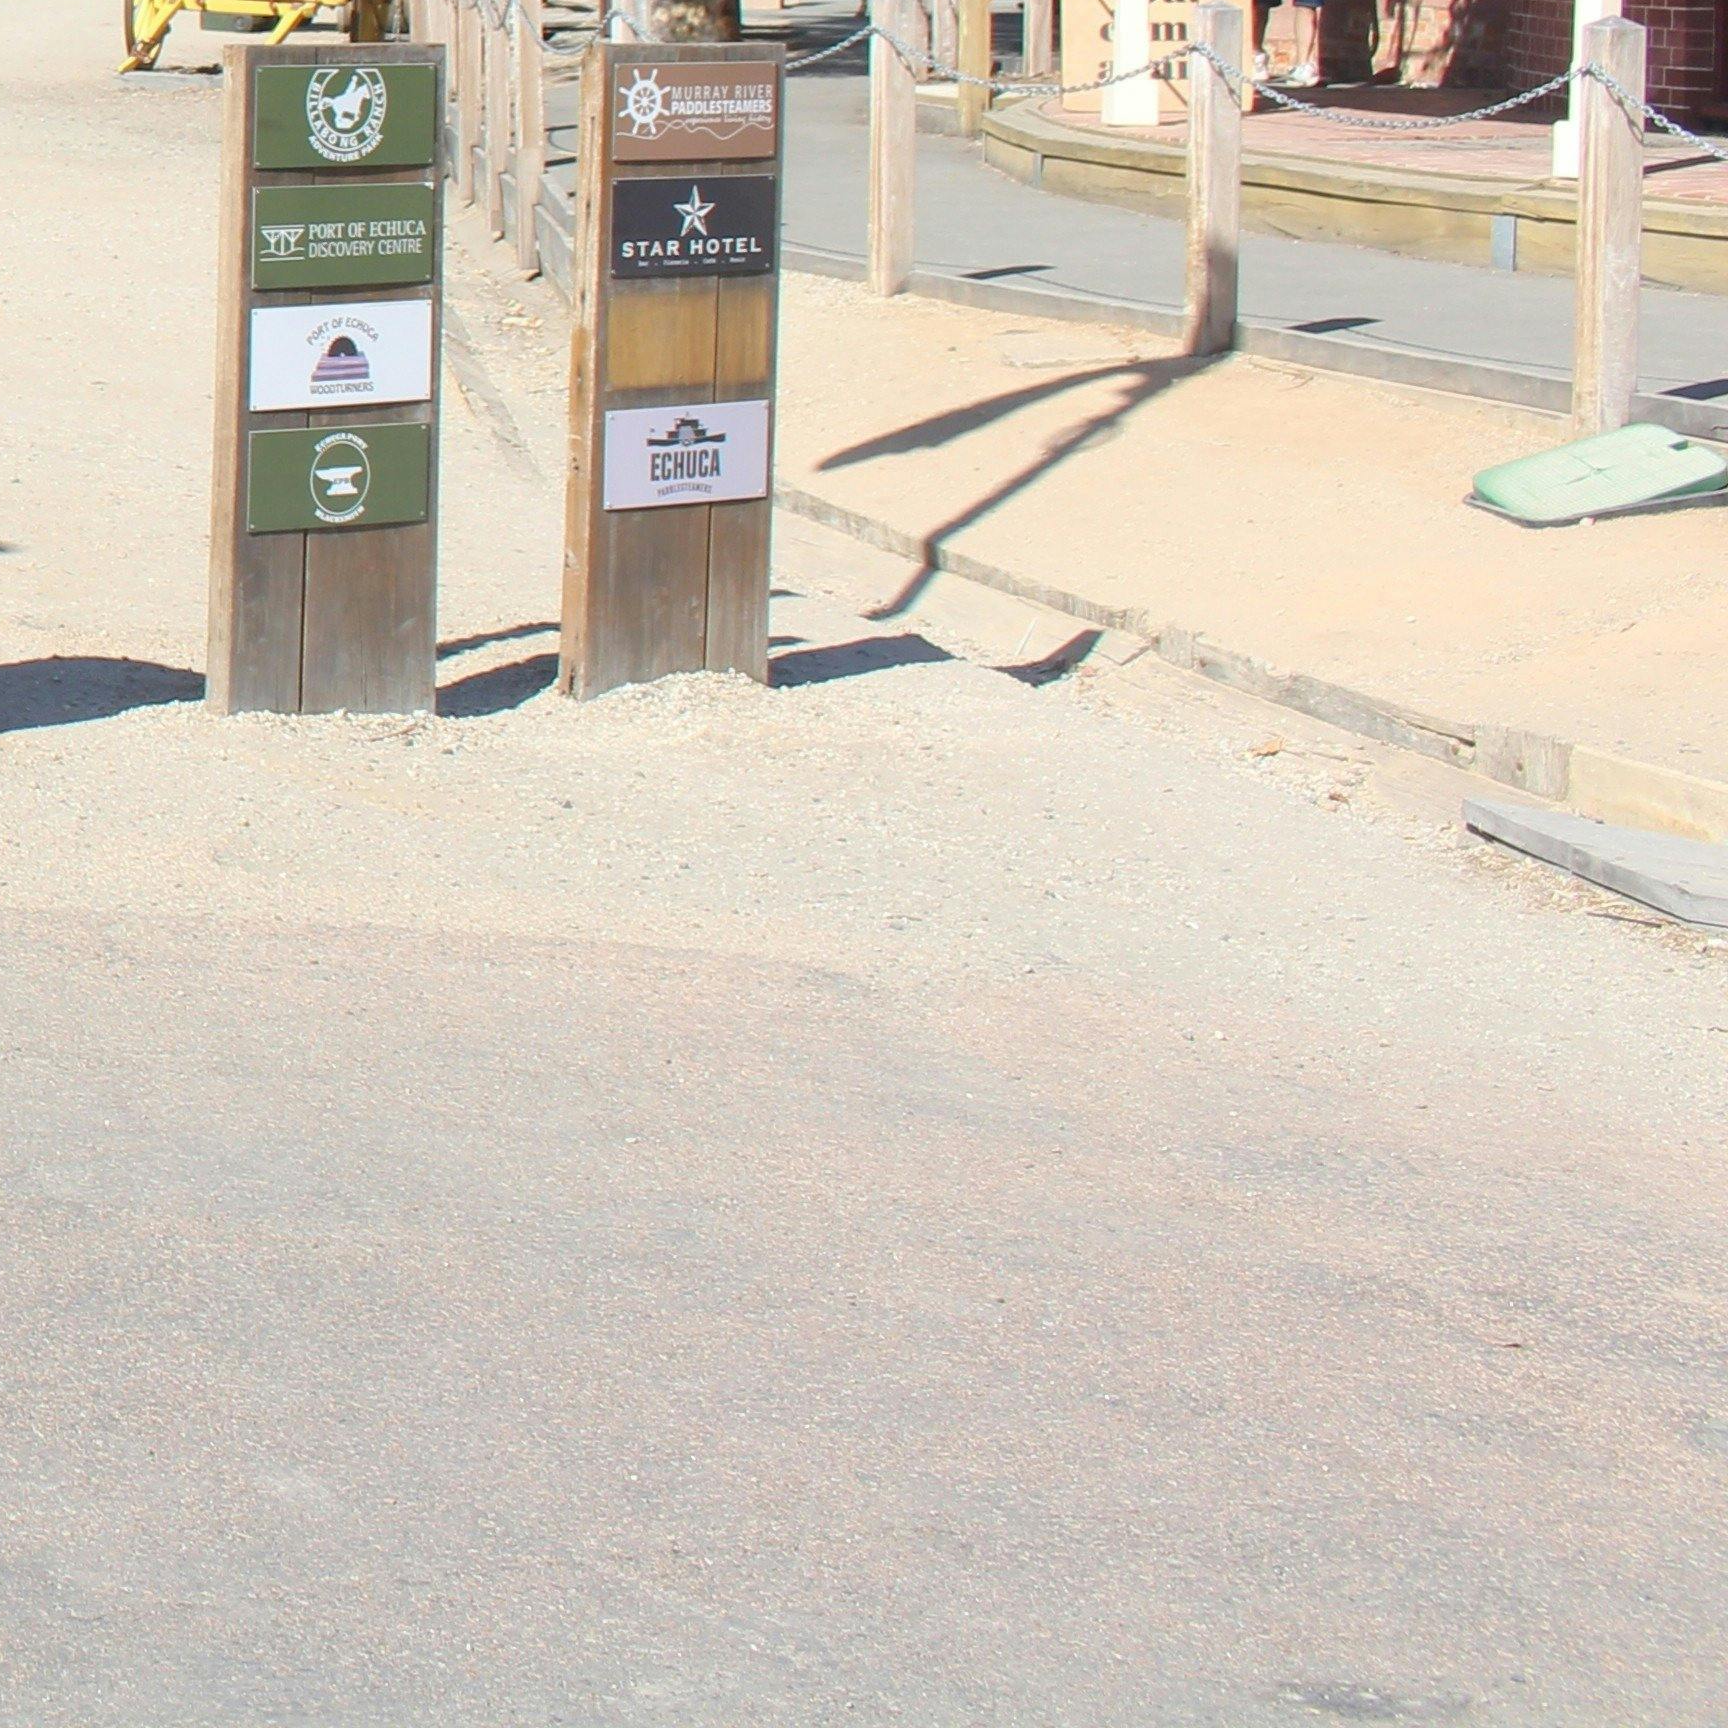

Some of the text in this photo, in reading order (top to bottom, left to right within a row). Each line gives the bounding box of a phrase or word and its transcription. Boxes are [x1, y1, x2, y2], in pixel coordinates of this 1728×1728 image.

[671, 84, 773, 100] MURRAY RIVER
[309, 82, 384, 147] BILLABONG RANCH
[671, 99, 773, 114] PADDLESTEAMERS
[308, 134, 384, 163] ADVENTURE PARK
[308, 219, 427, 240] PORT OF ECHUCA
[308, 237, 424, 258] DISCOVERY CENTRE
[621, 236, 762, 258] STAR HOTEL
[306, 316, 380, 346] PORT OF ECHUCA
[309, 381, 375, 395] WOODTURNERS
[650, 447, 721, 482] ECHUCA
